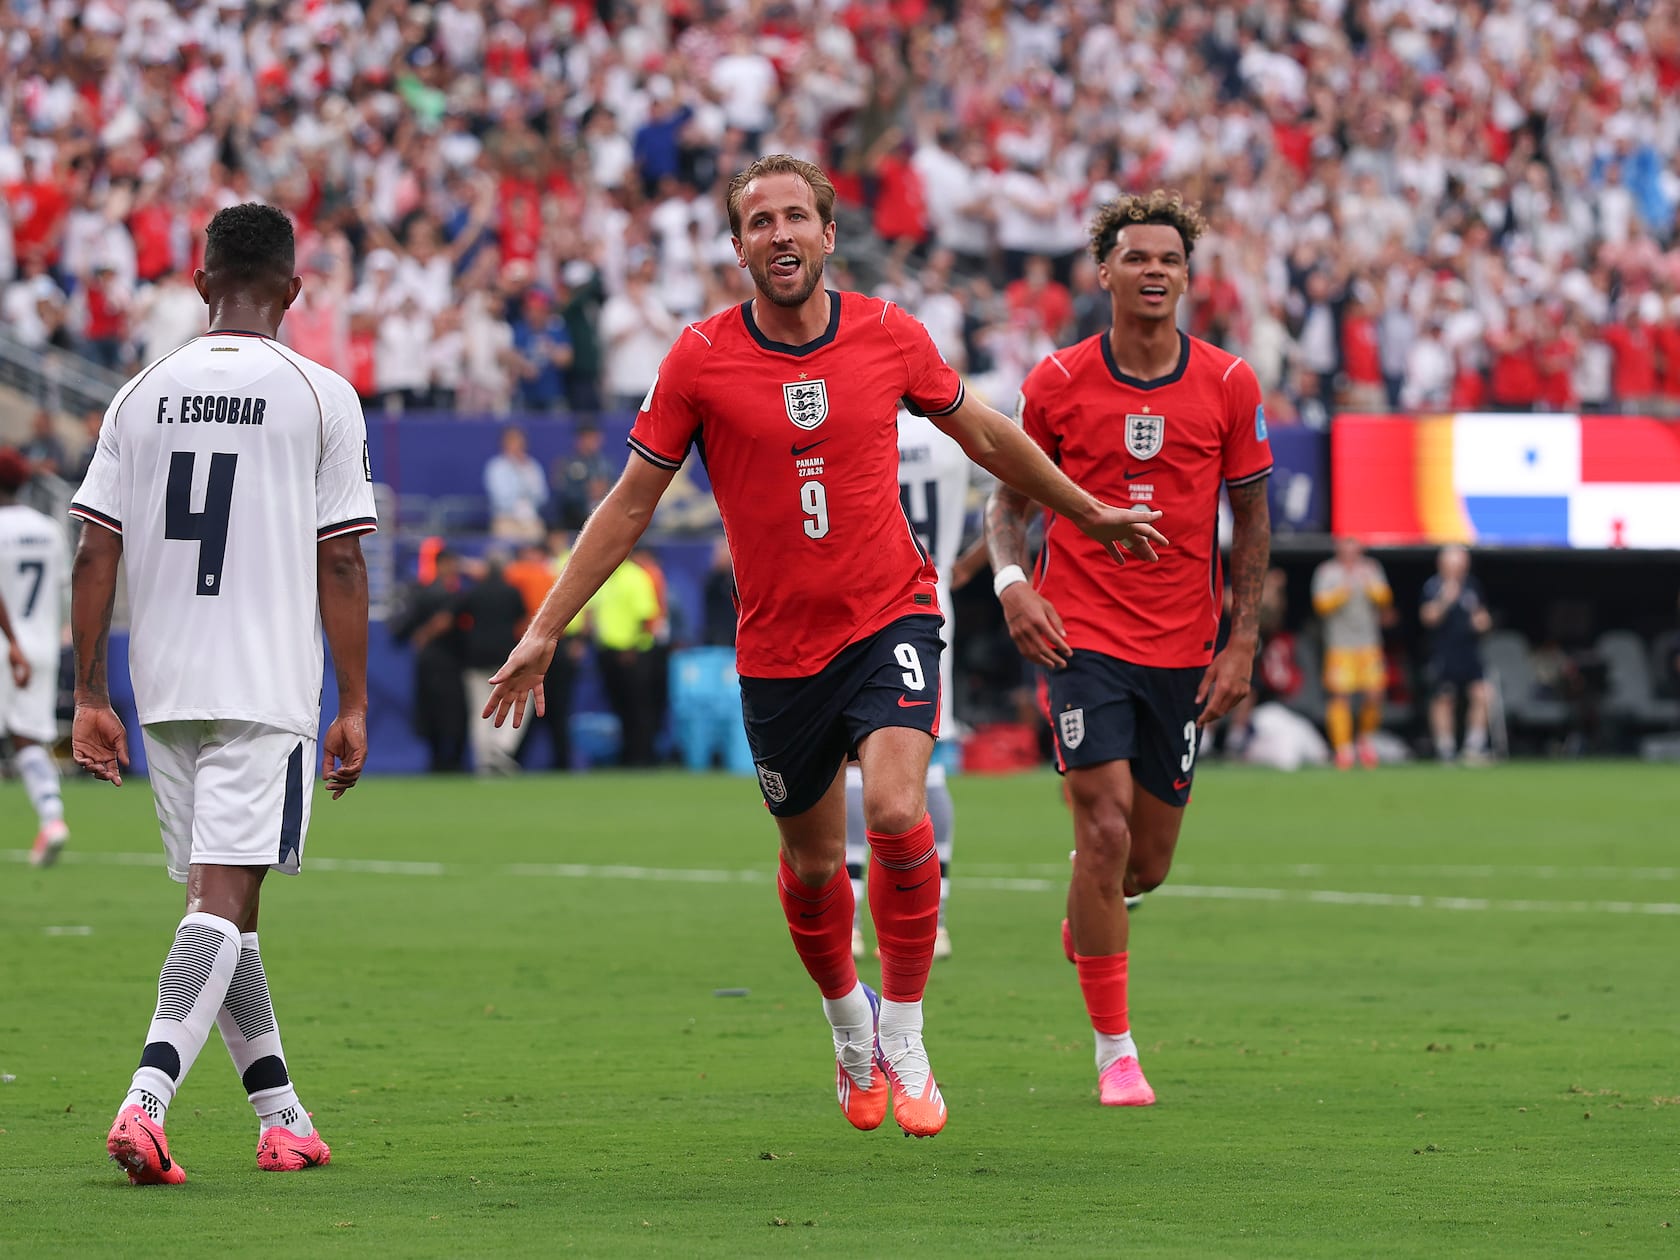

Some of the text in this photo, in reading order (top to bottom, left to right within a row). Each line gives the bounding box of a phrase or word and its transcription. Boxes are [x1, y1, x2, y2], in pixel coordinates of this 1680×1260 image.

[157, 395, 267, 425] F. ESCOBAR
[796, 457, 825, 468] PANAMA
[164, 451, 239, 596] 4
[800, 480, 830, 540] 9
[18, 559, 46, 619] 7
[893, 643, 926, 691] 9
[1181, 720, 1197, 773] 3
